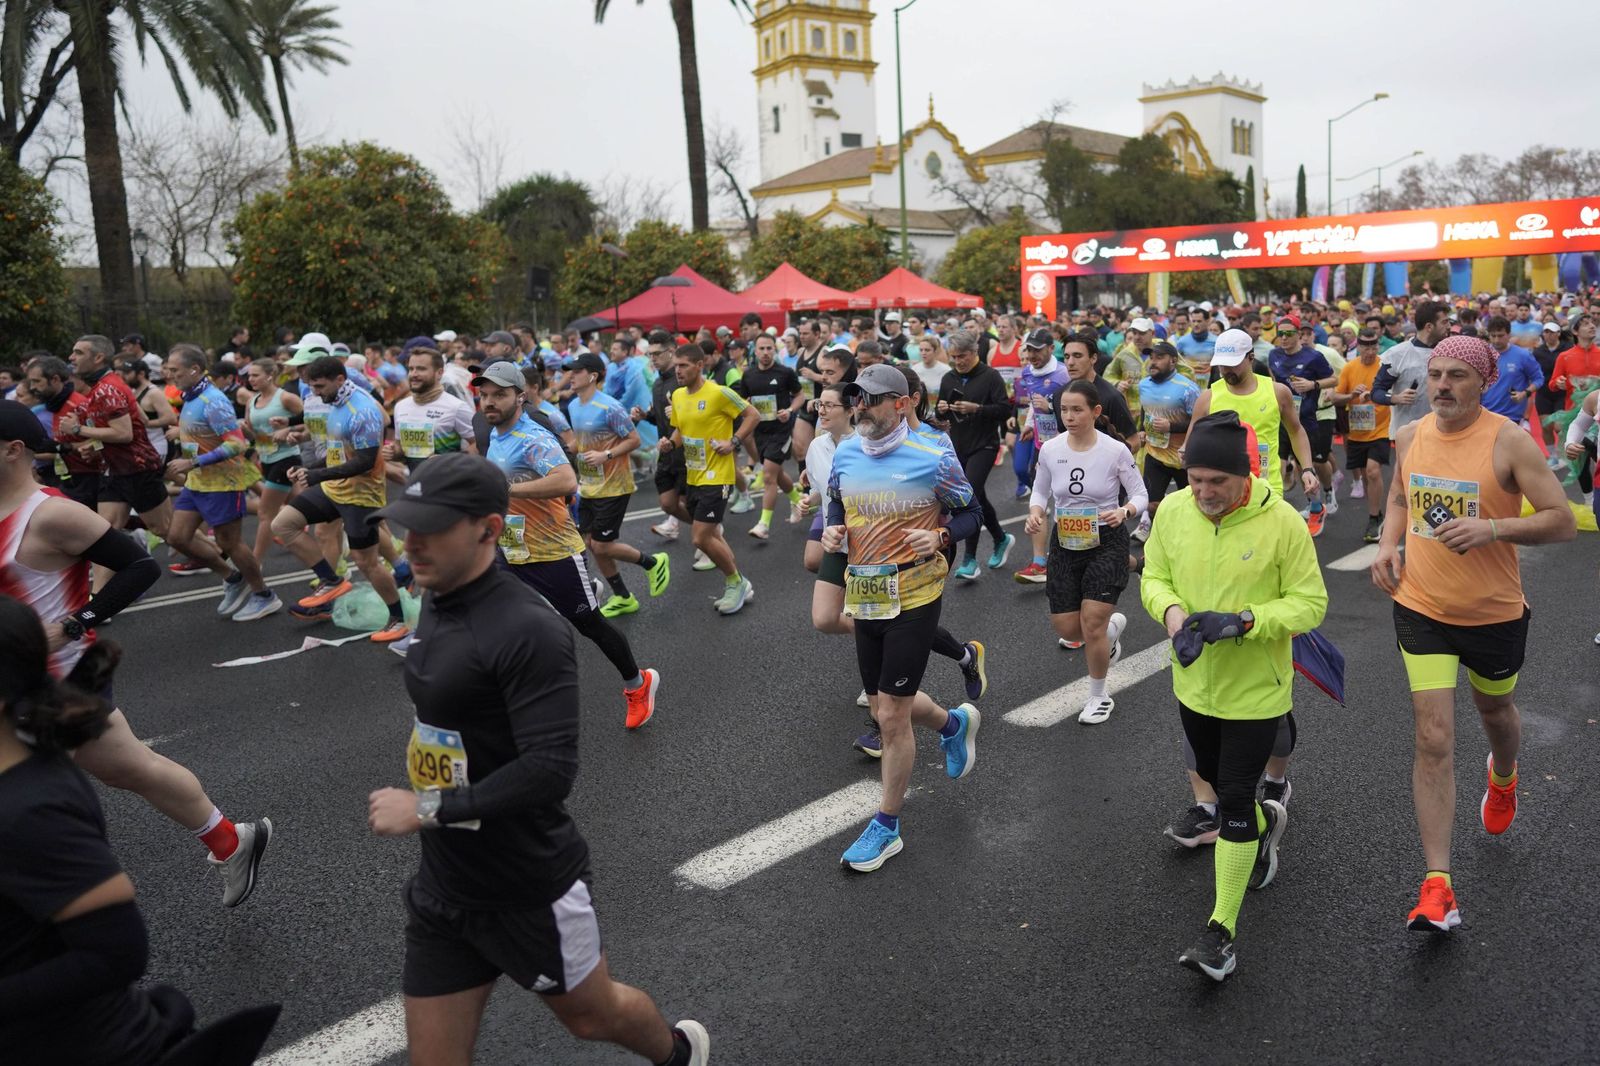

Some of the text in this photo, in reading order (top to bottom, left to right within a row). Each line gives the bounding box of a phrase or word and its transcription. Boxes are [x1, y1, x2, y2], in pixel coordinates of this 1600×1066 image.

[403, 430, 426, 442] 9502
[1068, 467, 1085, 496] GO
[1057, 518, 1091, 532] 15295
[849, 577, 888, 596] 11964
